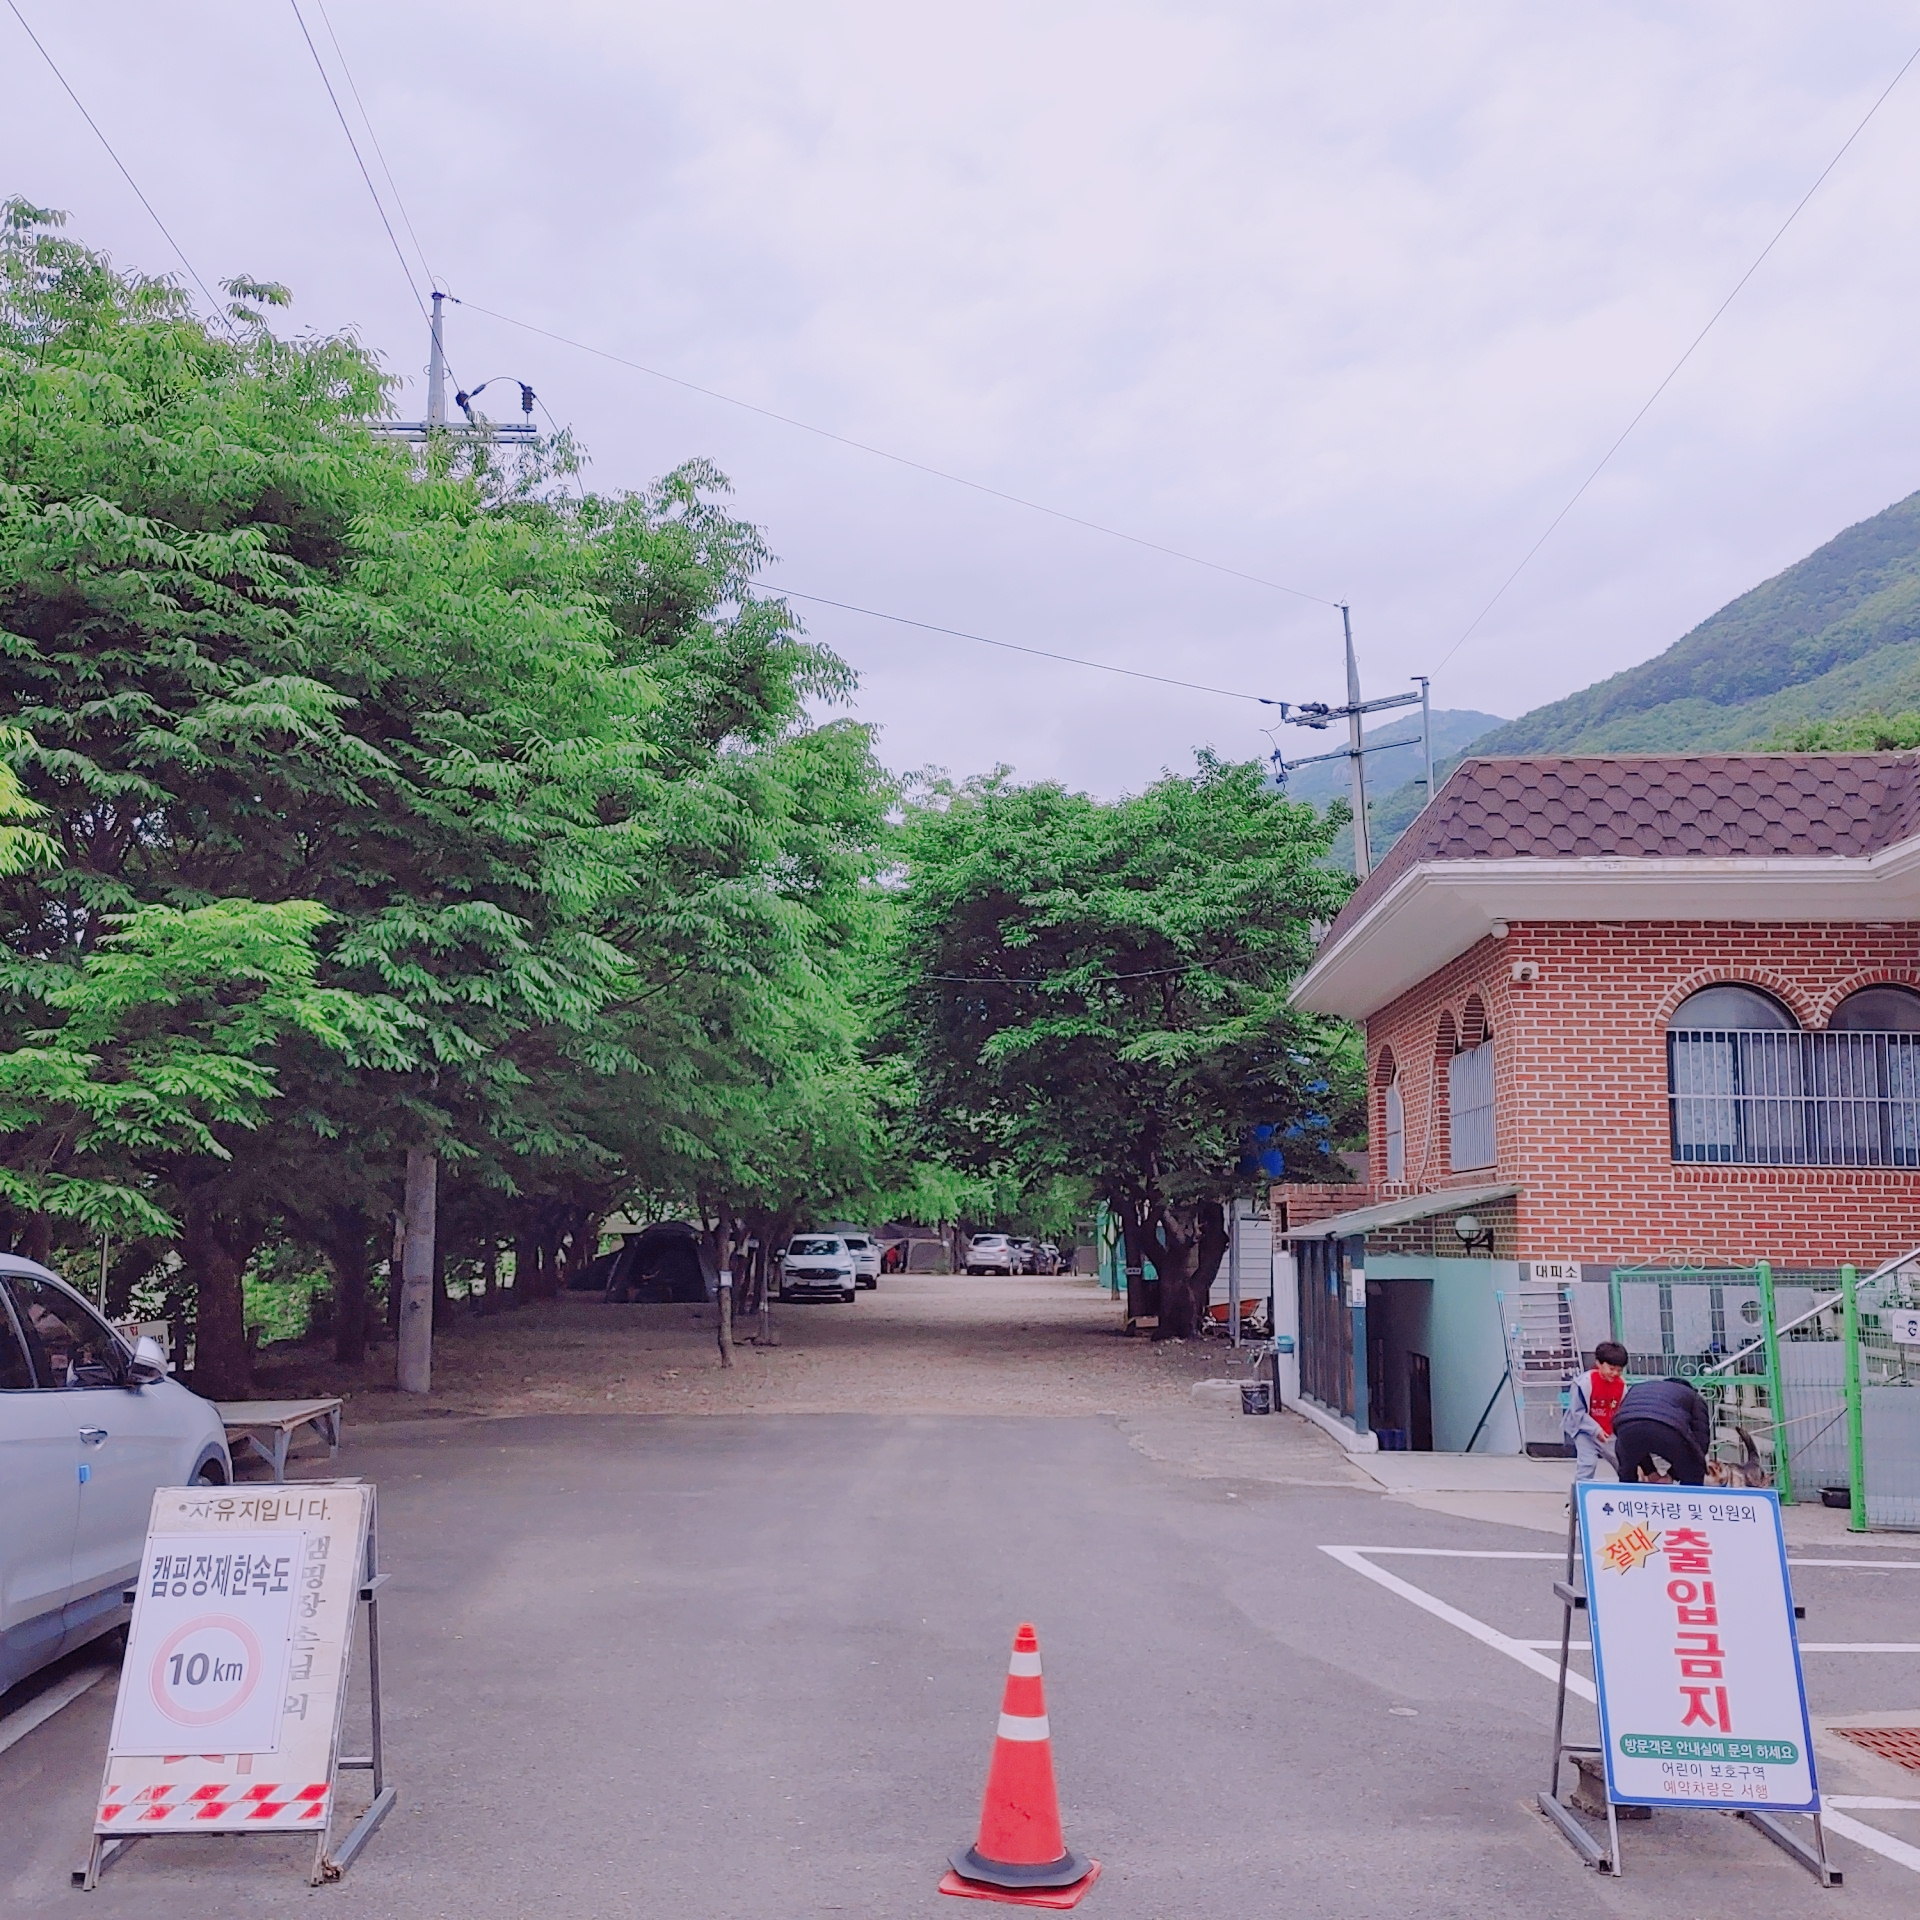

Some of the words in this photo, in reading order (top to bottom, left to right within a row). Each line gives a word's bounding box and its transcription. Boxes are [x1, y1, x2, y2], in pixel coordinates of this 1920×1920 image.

[1536, 1264, 1578, 1279] 대피소
[1618, 1500, 1682, 1520] 예약차량
[1688, 1503, 1703, 1521] 및
[1708, 1504, 1757, 1523] 인원외
[1605, 1526, 1654, 1567] 절대
[151, 1554, 291, 1598] 캠핑장제한속도
[1662, 1527, 1732, 1733] 출입금지
[1624, 1738, 1674, 1756] 방문객은
[1676, 1741, 1725, 1758] 안내실에
[1728, 1743, 1753, 1759] 문의
[1757, 1745, 1794, 1760] 하세요
[1661, 1761, 1703, 1778] 어린이
[1710, 1764, 1766, 1782] 보호구역
[1663, 1780, 1735, 1798] 예약차량은
[1741, 1783, 1769, 1800] 서행
